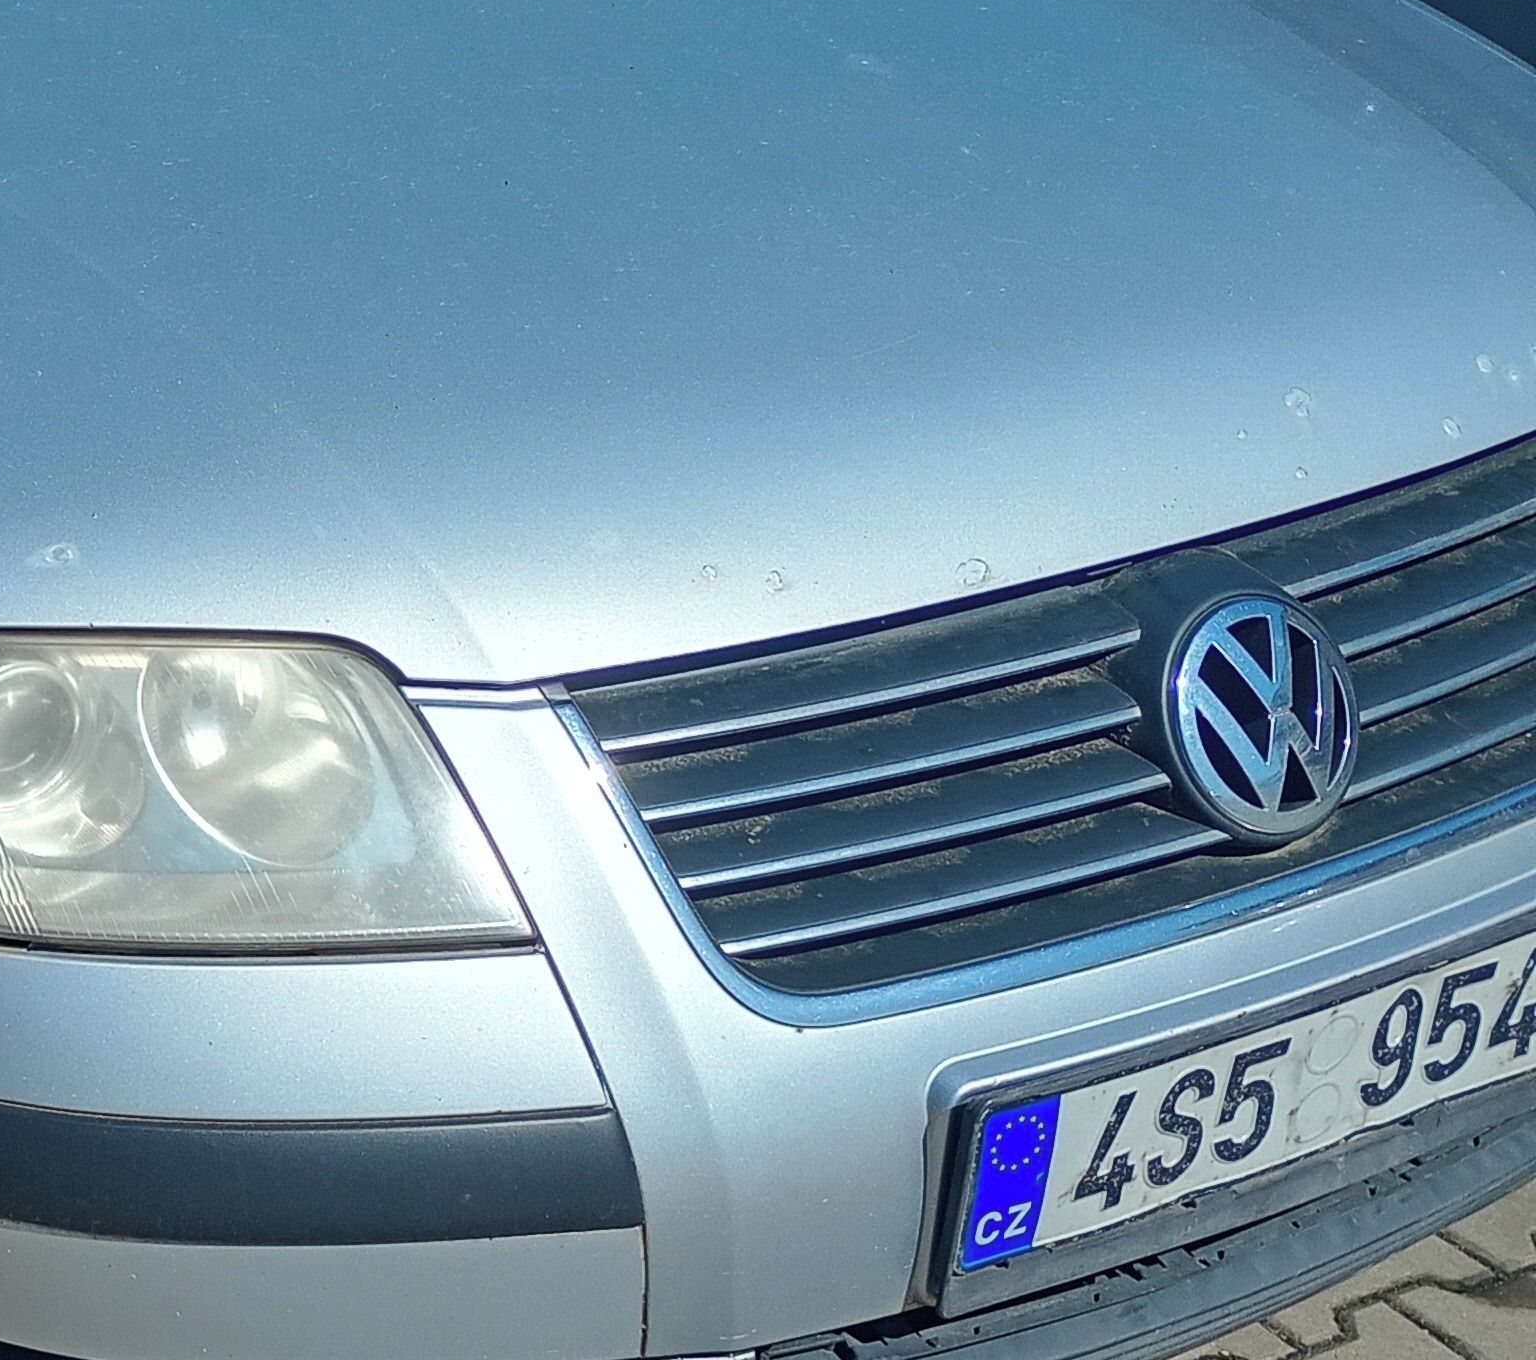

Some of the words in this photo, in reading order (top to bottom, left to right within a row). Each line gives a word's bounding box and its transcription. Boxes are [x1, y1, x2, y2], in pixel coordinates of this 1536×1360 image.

[1359, 945, 1536, 1108] 954
[1072, 1036, 1293, 1211] 4S5
[973, 1200, 1034, 1247] CZ
